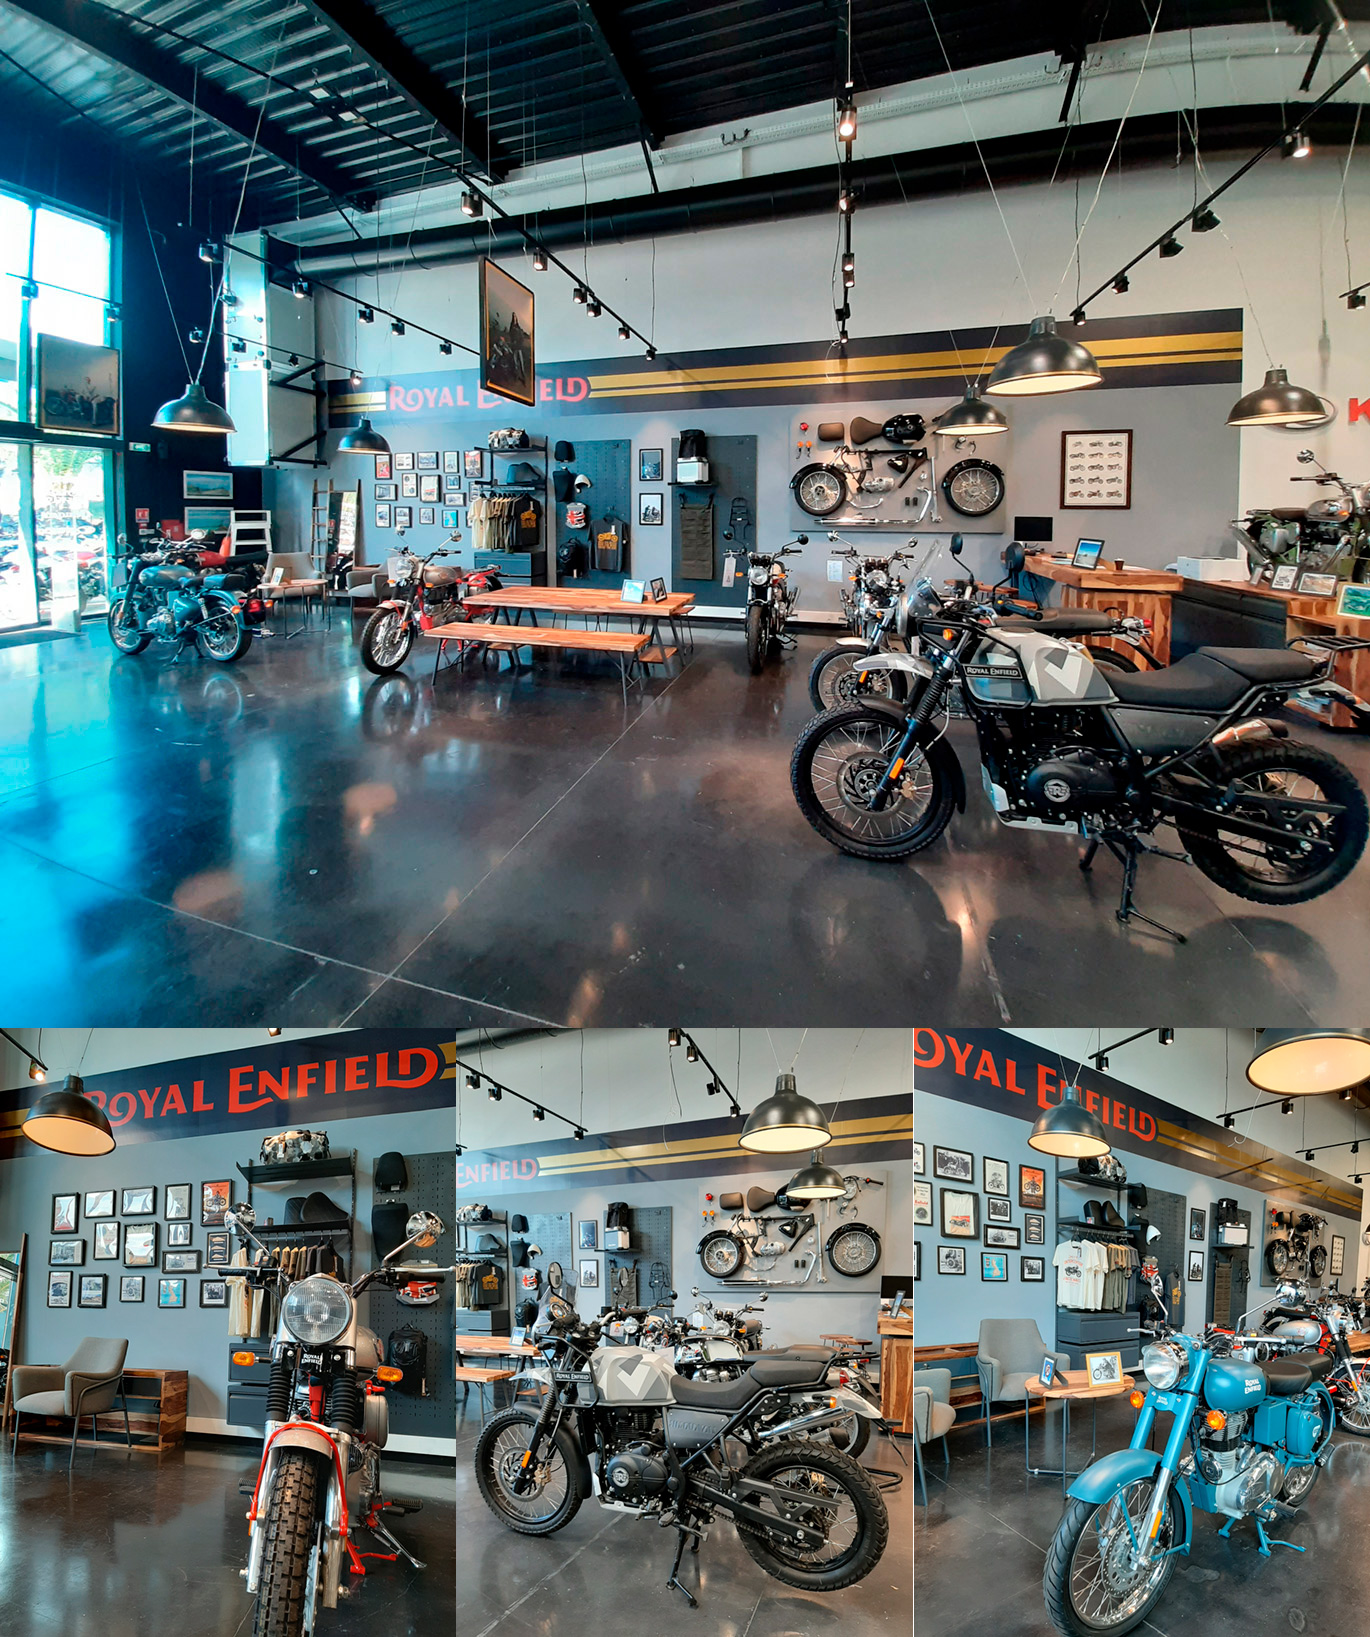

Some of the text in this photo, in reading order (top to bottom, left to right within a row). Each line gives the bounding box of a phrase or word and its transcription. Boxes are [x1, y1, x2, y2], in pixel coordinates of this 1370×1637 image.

[389, 376, 588, 411] ROYAL EELD
[228, 1047, 439, 1114] ENFIELD
[457, 1158, 537, 1189] ENFIELD
[1244, 1384, 1261, 1394] ENFIELD
[1245, 1379, 1260, 1387] ROYAL
